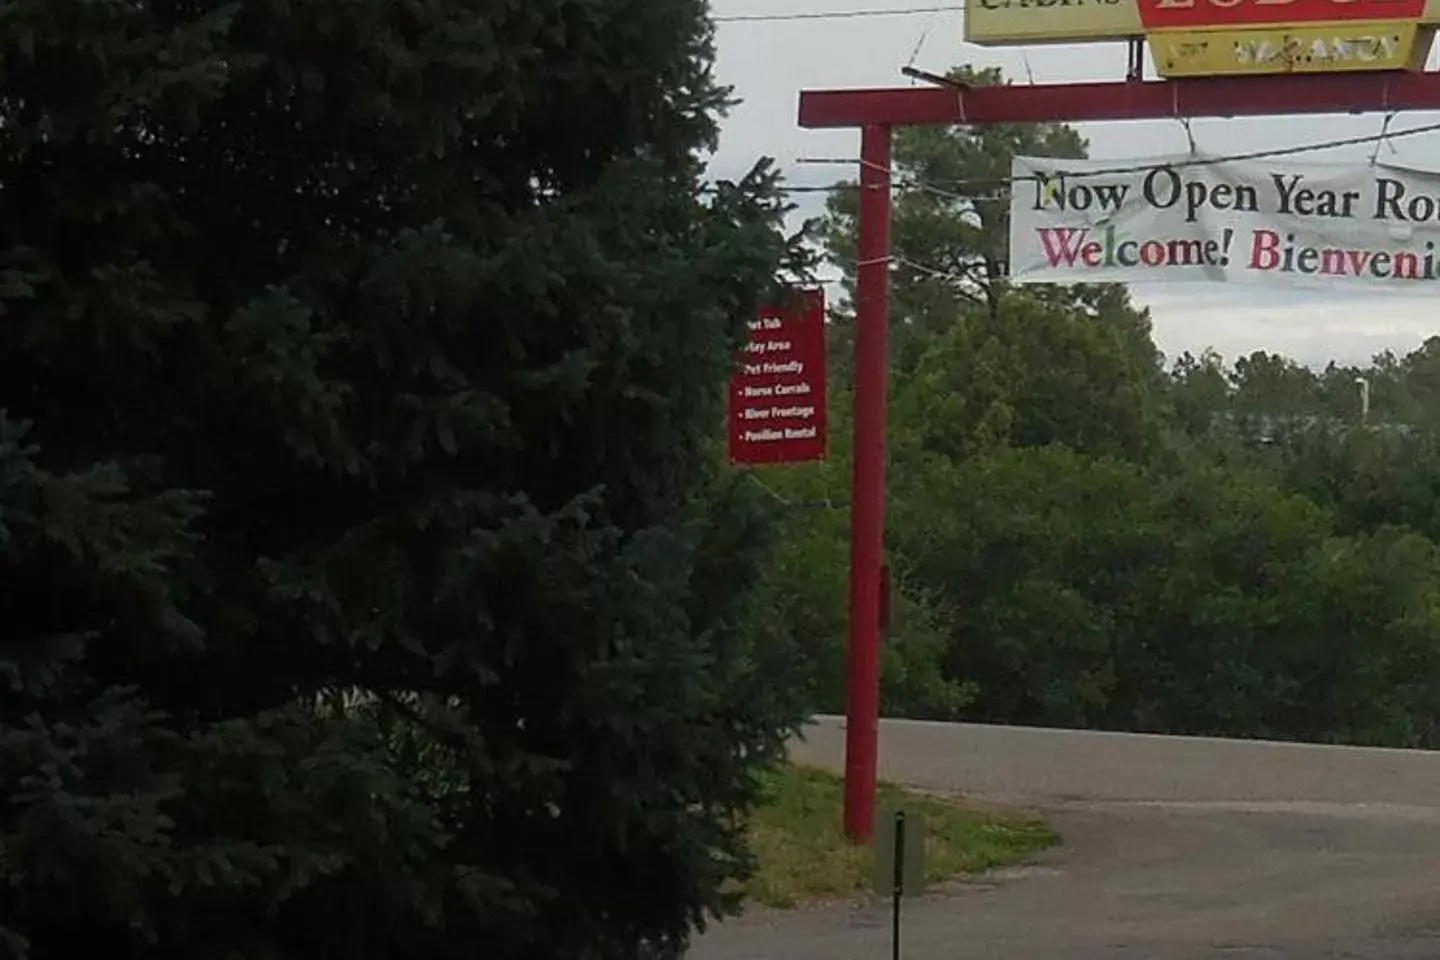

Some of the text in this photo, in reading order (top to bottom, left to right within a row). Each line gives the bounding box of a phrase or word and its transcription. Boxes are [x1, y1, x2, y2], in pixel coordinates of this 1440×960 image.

[1031, 171, 1129, 212] Now
[1143, 164, 1259, 222] Open
[1270, 174, 1360, 219] Year
[1035, 225, 1235, 270] Welcome!
[767, 340, 791, 351] Area
[763, 361, 803, 374] Friendly
[744, 382, 810, 396] Horse Corrals
[744, 405, 815, 419] River Frontage
[785, 426, 816, 438] Rental
